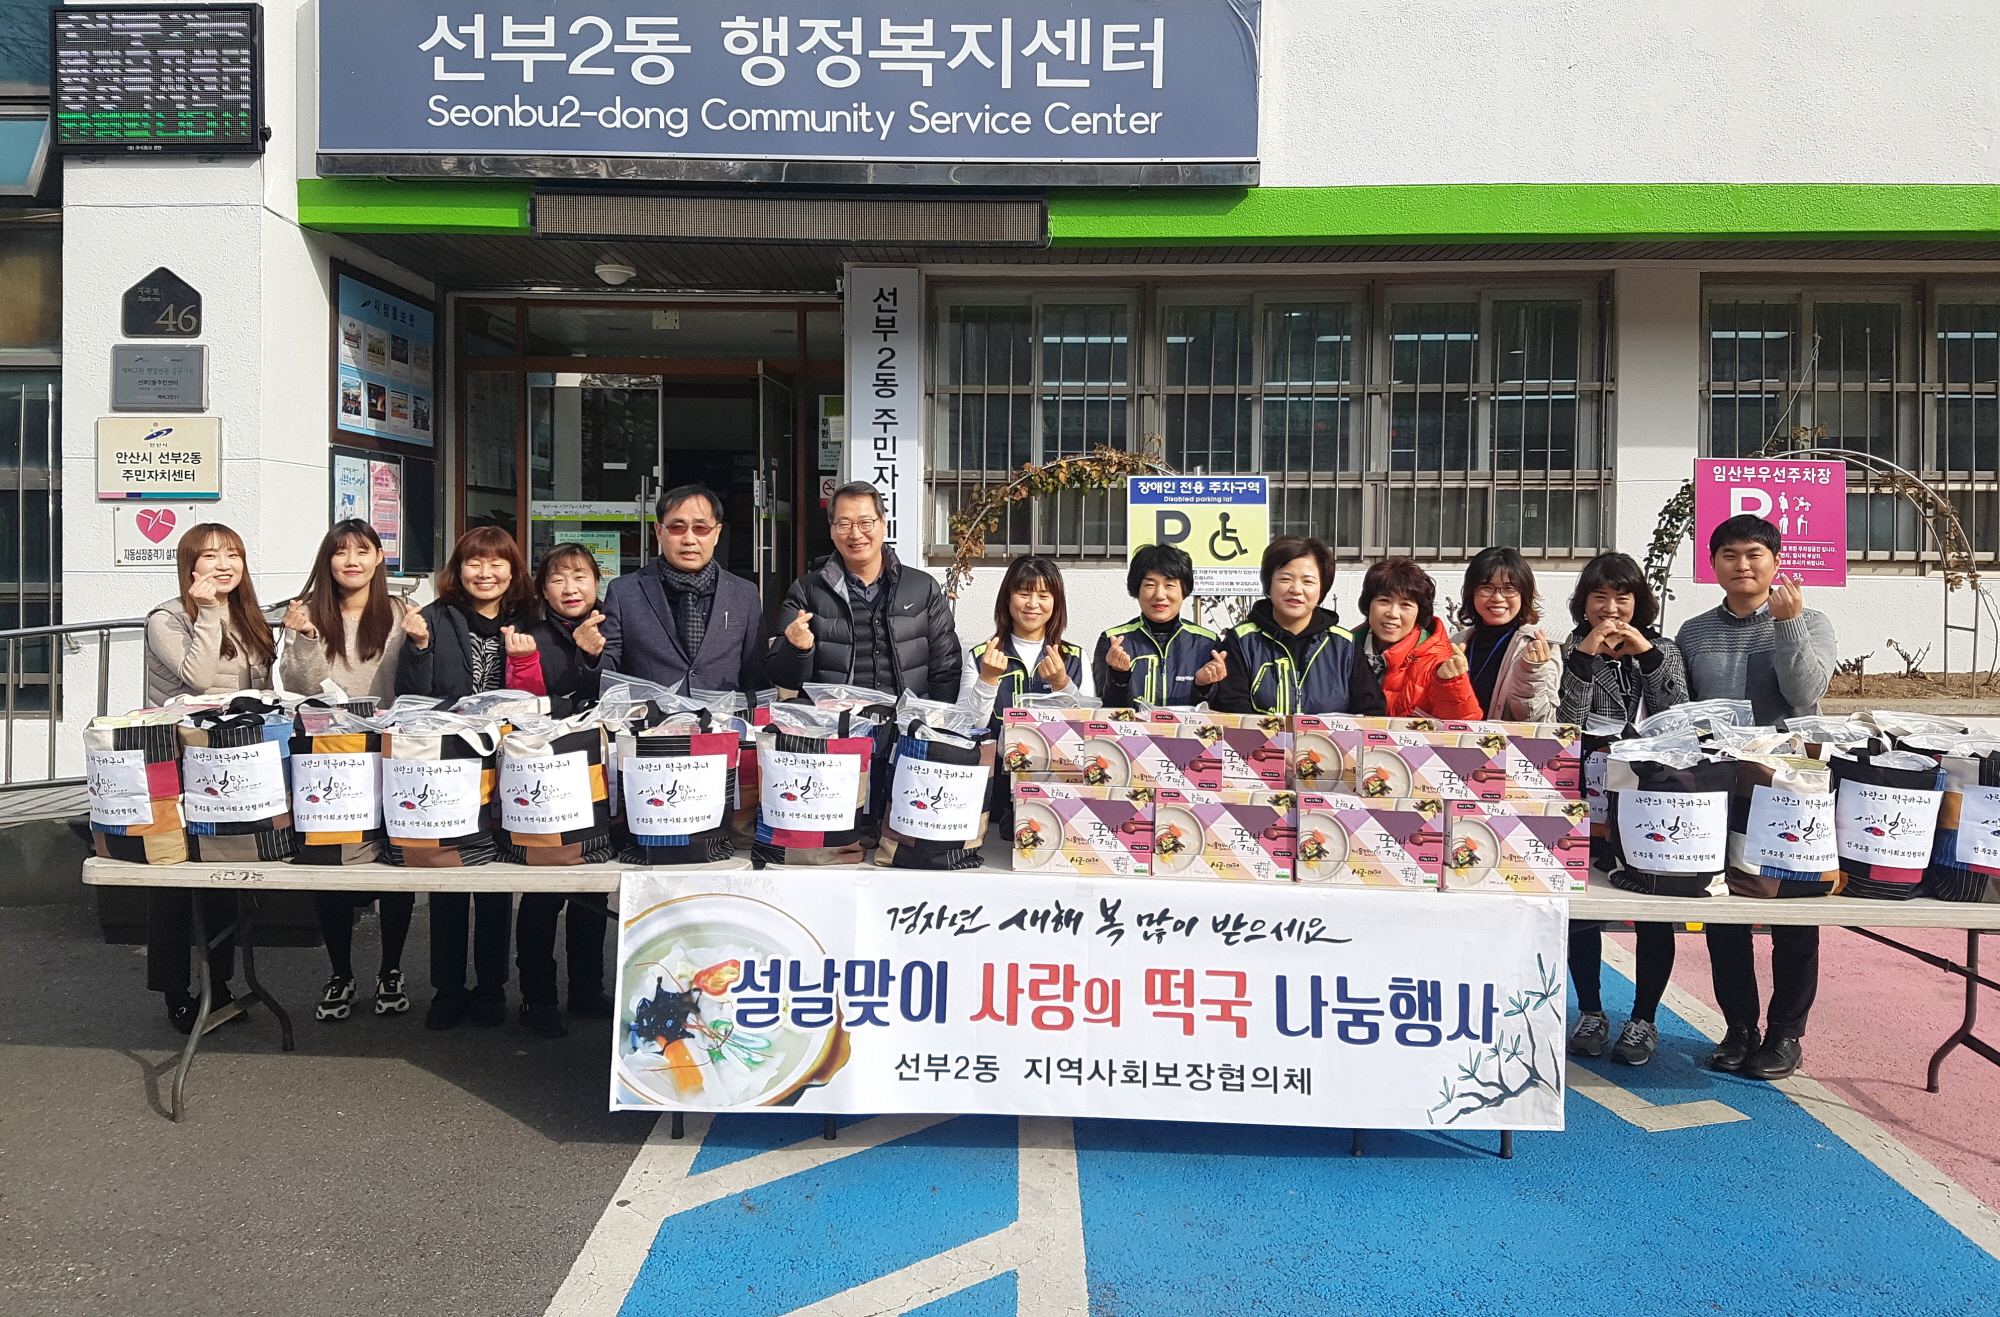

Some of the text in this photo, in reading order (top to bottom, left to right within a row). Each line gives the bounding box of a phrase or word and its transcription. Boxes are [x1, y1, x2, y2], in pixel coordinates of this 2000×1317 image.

[417, 13, 1165, 89] 선부2동 행정복지센터
[427, 94, 1163, 141] Seonbu2-dong Community Service Center
[155, 303, 198, 332] 46
[871, 286, 899, 399] 선부2동
[116, 451, 203, 465] 안산시 선부2동
[121, 469, 196, 482] 주민자치센터
[1713, 465, 1832, 485] 임산부우선주차장
[1137, 481, 1260, 495] 장애인 전용 주차구역
[1195, 496, 1222, 504] parking
[1155, 510, 1192, 547] P
[886, 897, 1353, 947] 경자년 새해 복 많이 받으세요
[731, 957, 1500, 1048] 설날맞이 사랑의 떡국 나눔행사
[894, 1053, 1313, 1096] 선부2동 지역사회보장협의체
